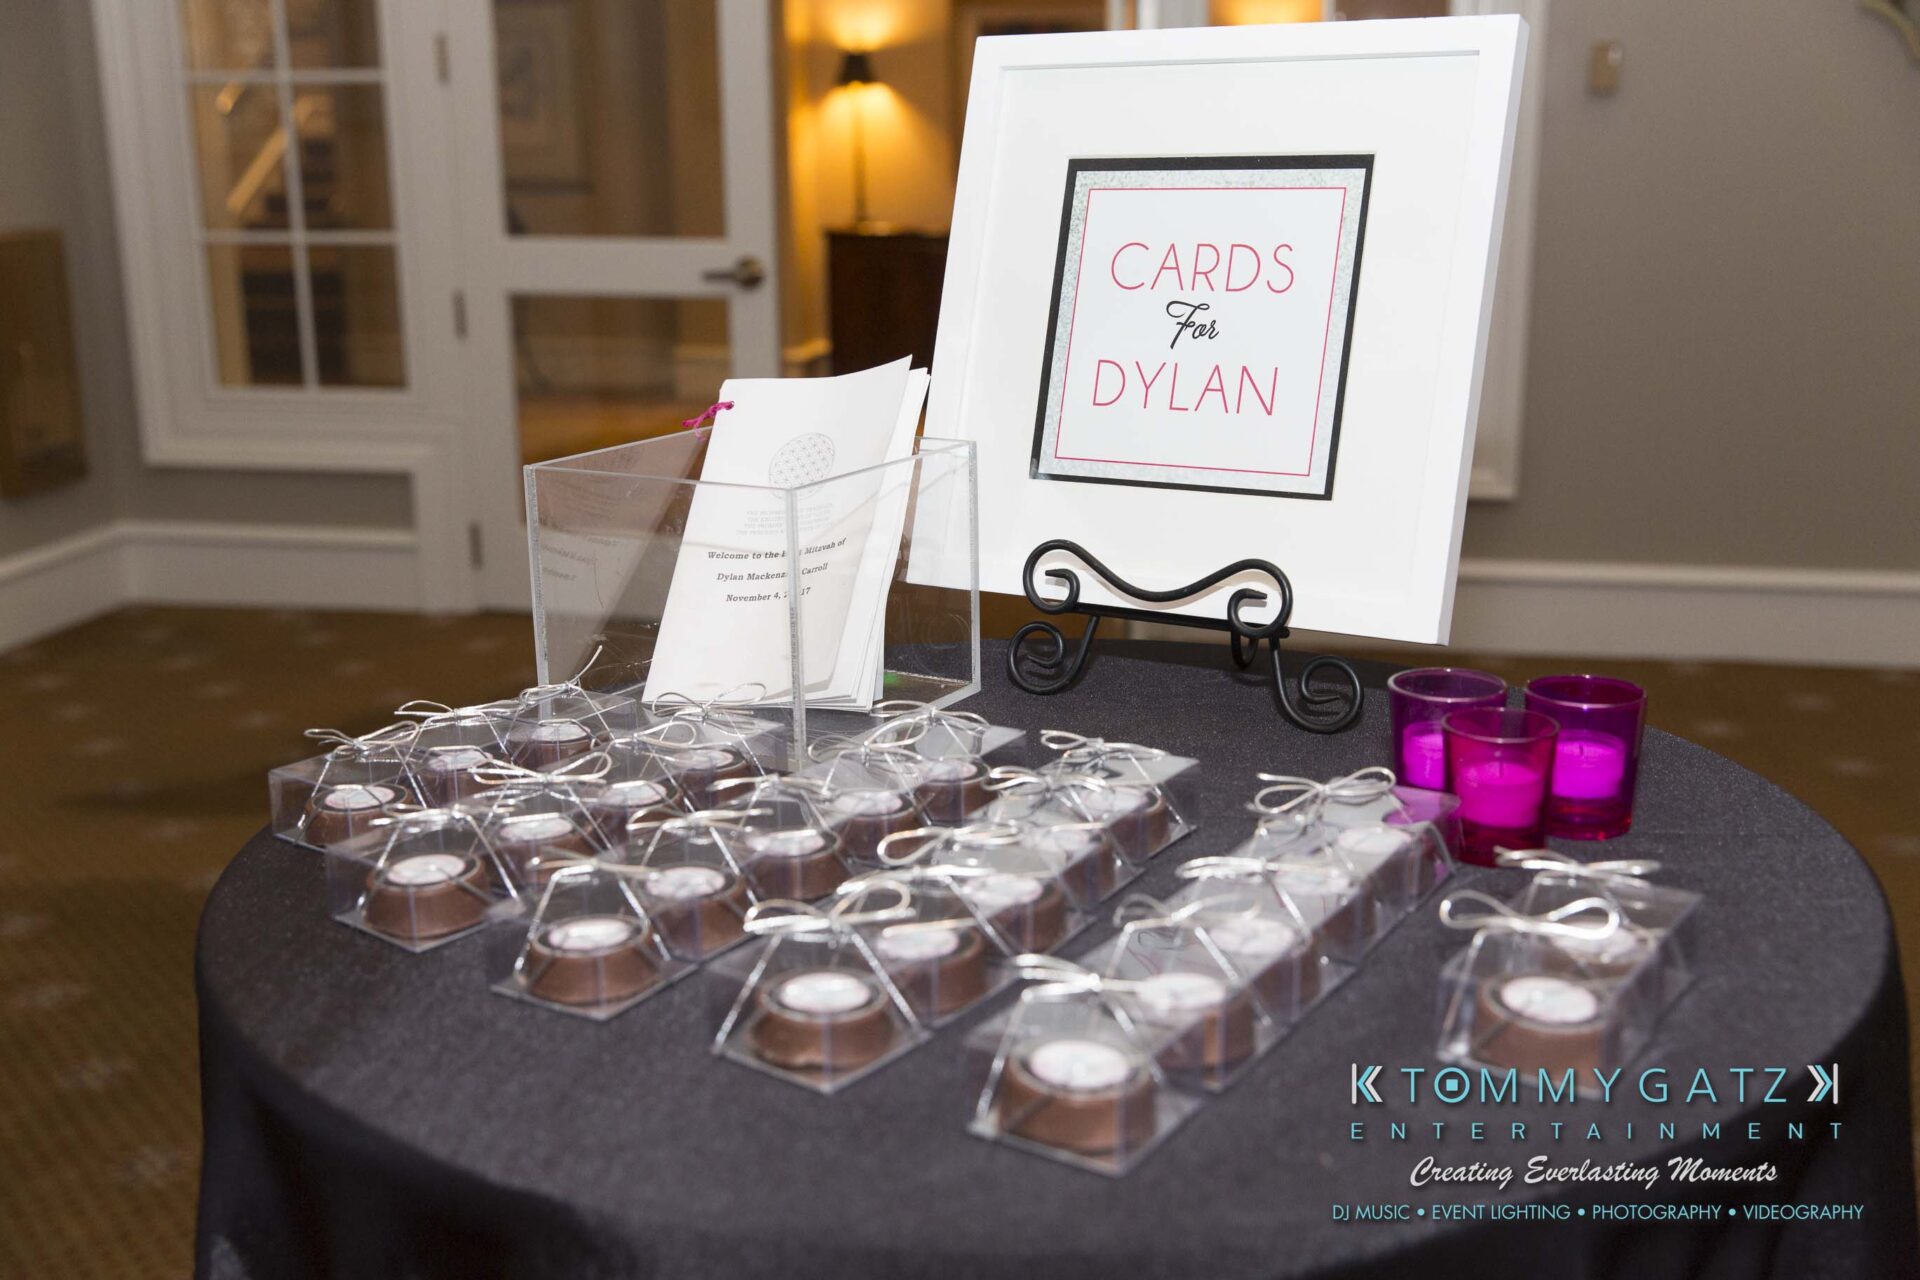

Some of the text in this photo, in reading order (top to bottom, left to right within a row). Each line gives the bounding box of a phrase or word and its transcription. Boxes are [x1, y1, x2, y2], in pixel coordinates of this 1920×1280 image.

[1110, 241, 1295, 295] CARDS
[1166, 300, 1219, 350] For
[1092, 359, 1279, 417] DYLAN
[707, 551, 750, 560] Welcome
[752, 552, 762, 560] to
[764, 551, 780, 559] the
[805, 541, 836, 555] Mitzvah
[837, 537, 847, 547] of
[716, 572, 744, 583] Dylan
[801, 562, 829, 576] Carroll
[725, 593, 772, 603] November
[773, 592, 782, 600] 4,
